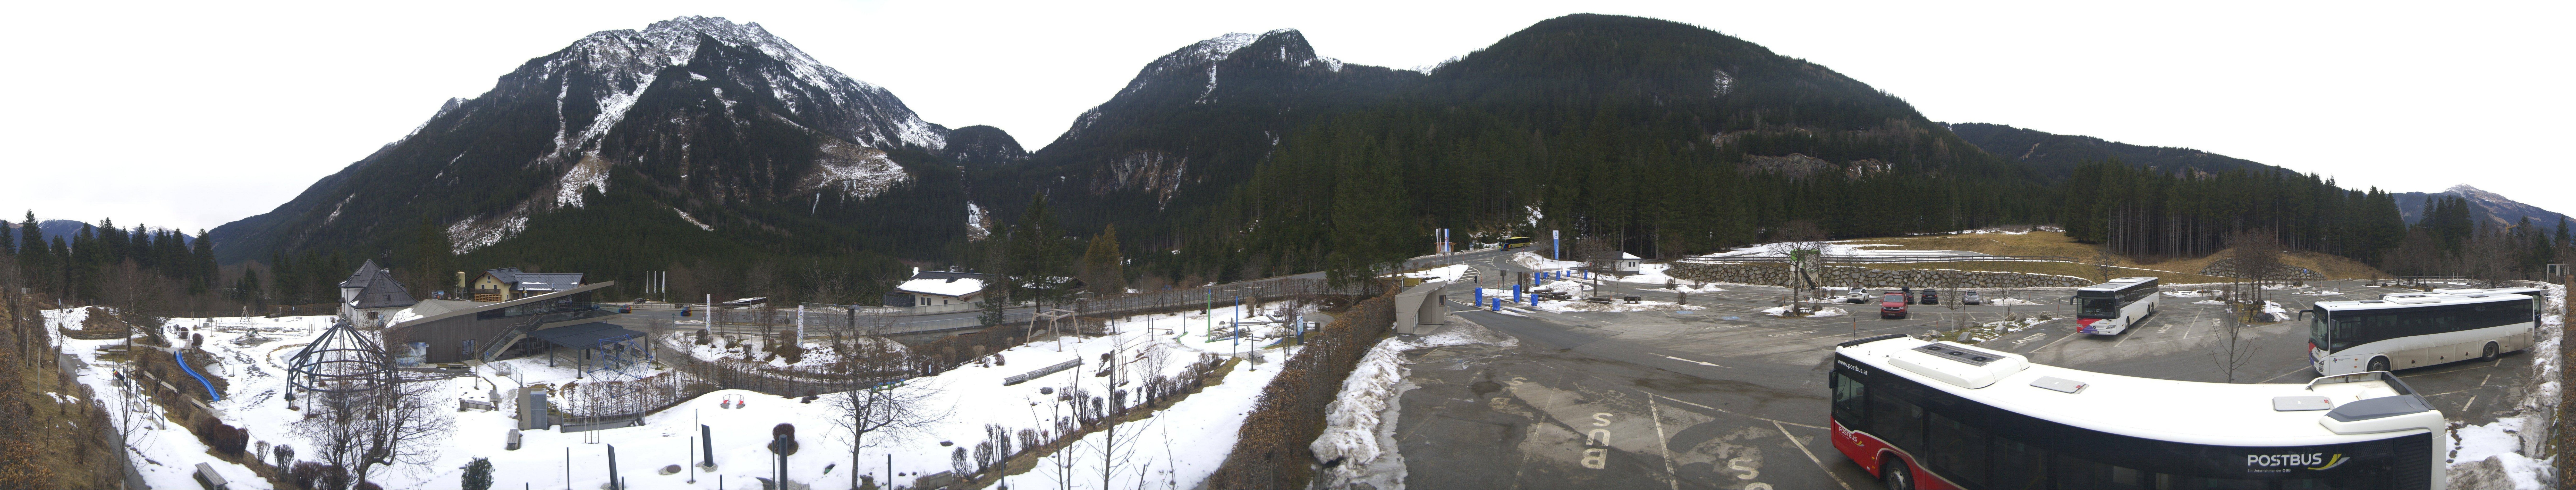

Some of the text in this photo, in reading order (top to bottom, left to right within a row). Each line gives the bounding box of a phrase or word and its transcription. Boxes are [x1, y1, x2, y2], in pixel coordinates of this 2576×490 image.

[2156, 324, 2173, 333] BUS
[2012, 333, 2046, 344] BUS
[1837, 359, 1868, 376] www.postbus.at
[1488, 377, 1527, 409] BUS
[1581, 413, 1613, 469] BUS
[1839, 426, 1857, 442] POSTBUS
[2248, 453, 2322, 466] POSTBUS
